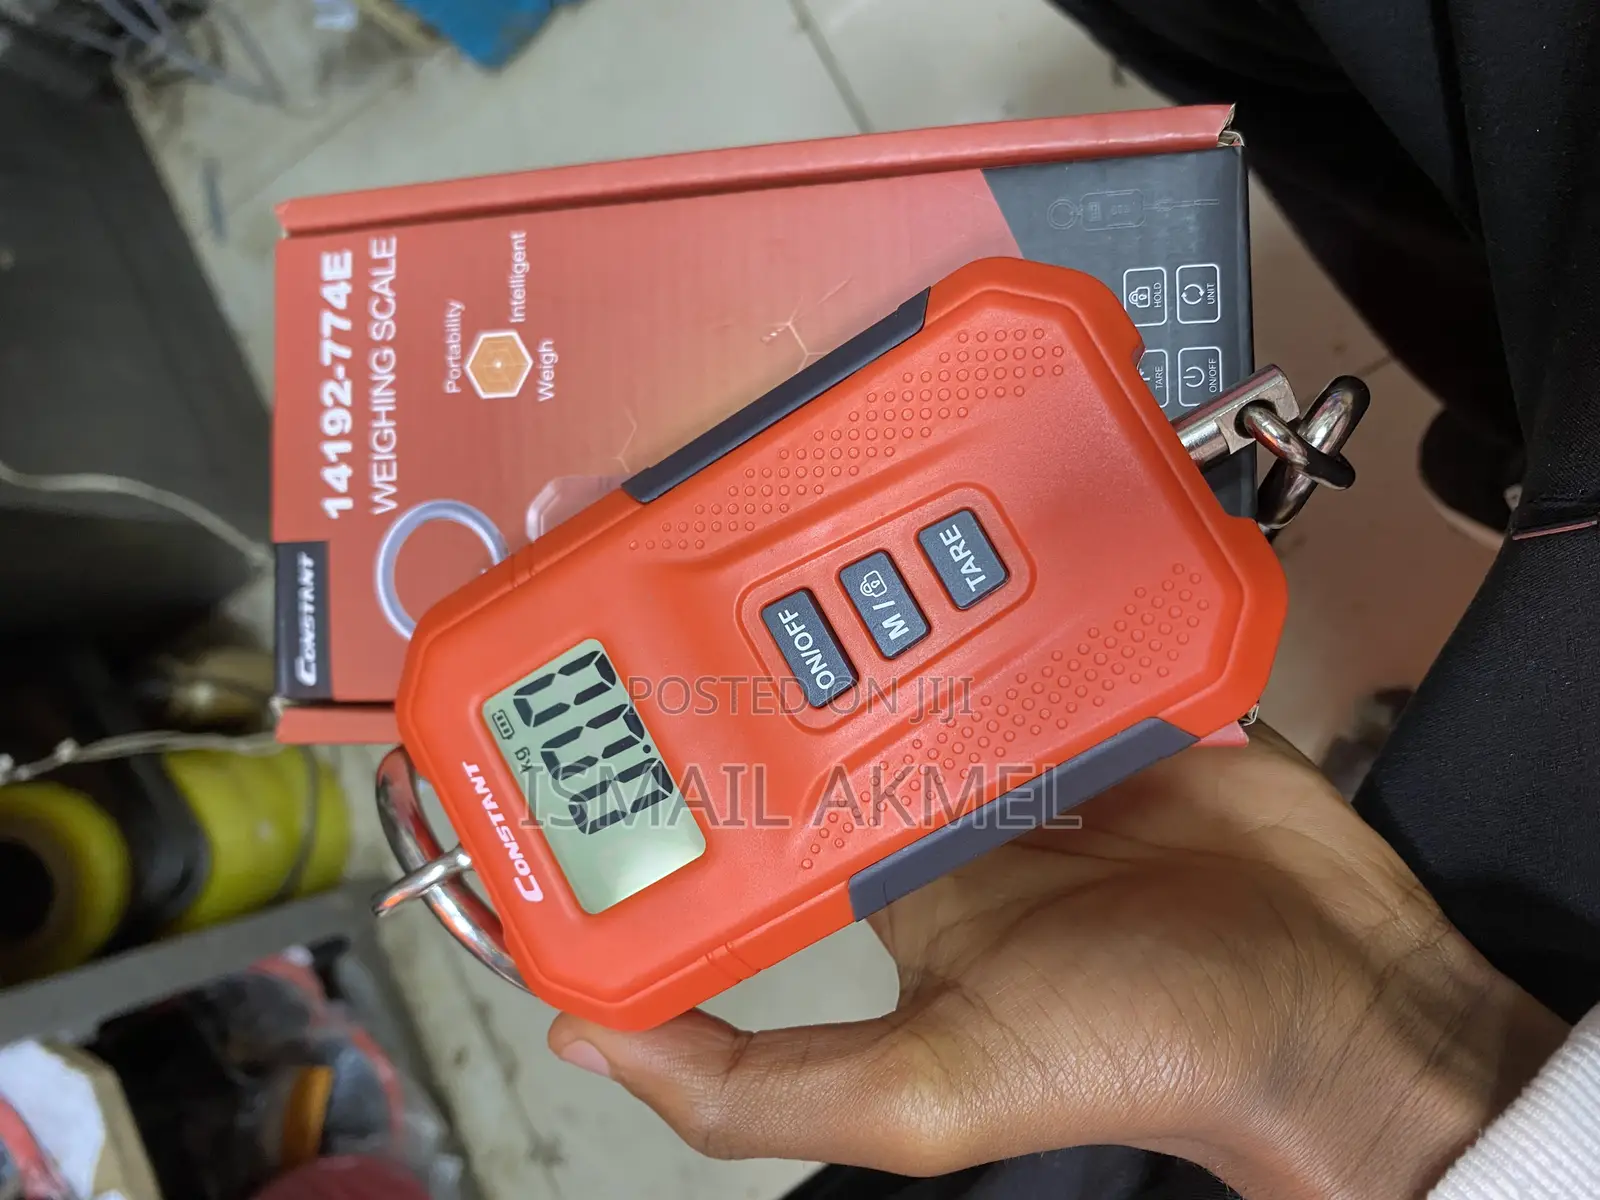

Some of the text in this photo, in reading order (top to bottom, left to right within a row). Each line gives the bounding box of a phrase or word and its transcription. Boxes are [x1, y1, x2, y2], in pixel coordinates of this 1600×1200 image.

[509, 230, 529, 323] Intelligent
[1153, 282, 1162, 308] HOLD
[1206, 282, 1216, 305] UNIT
[369, 236, 398, 515] WEIGHING SCALE
[444, 299, 466, 393] Portability
[538, 339, 559, 402] Weigh
[1155, 366, 1164, 390] TARE
[1208, 358, 1218, 393] ON/OFF
[320, 249, 353, 519] 14192-774E
[938, 524, 987, 593] TARE
[777, 608, 836, 690] ON/OFF
[513, 650, 675, 836] 0.00
[514, 746, 534, 773] kg
